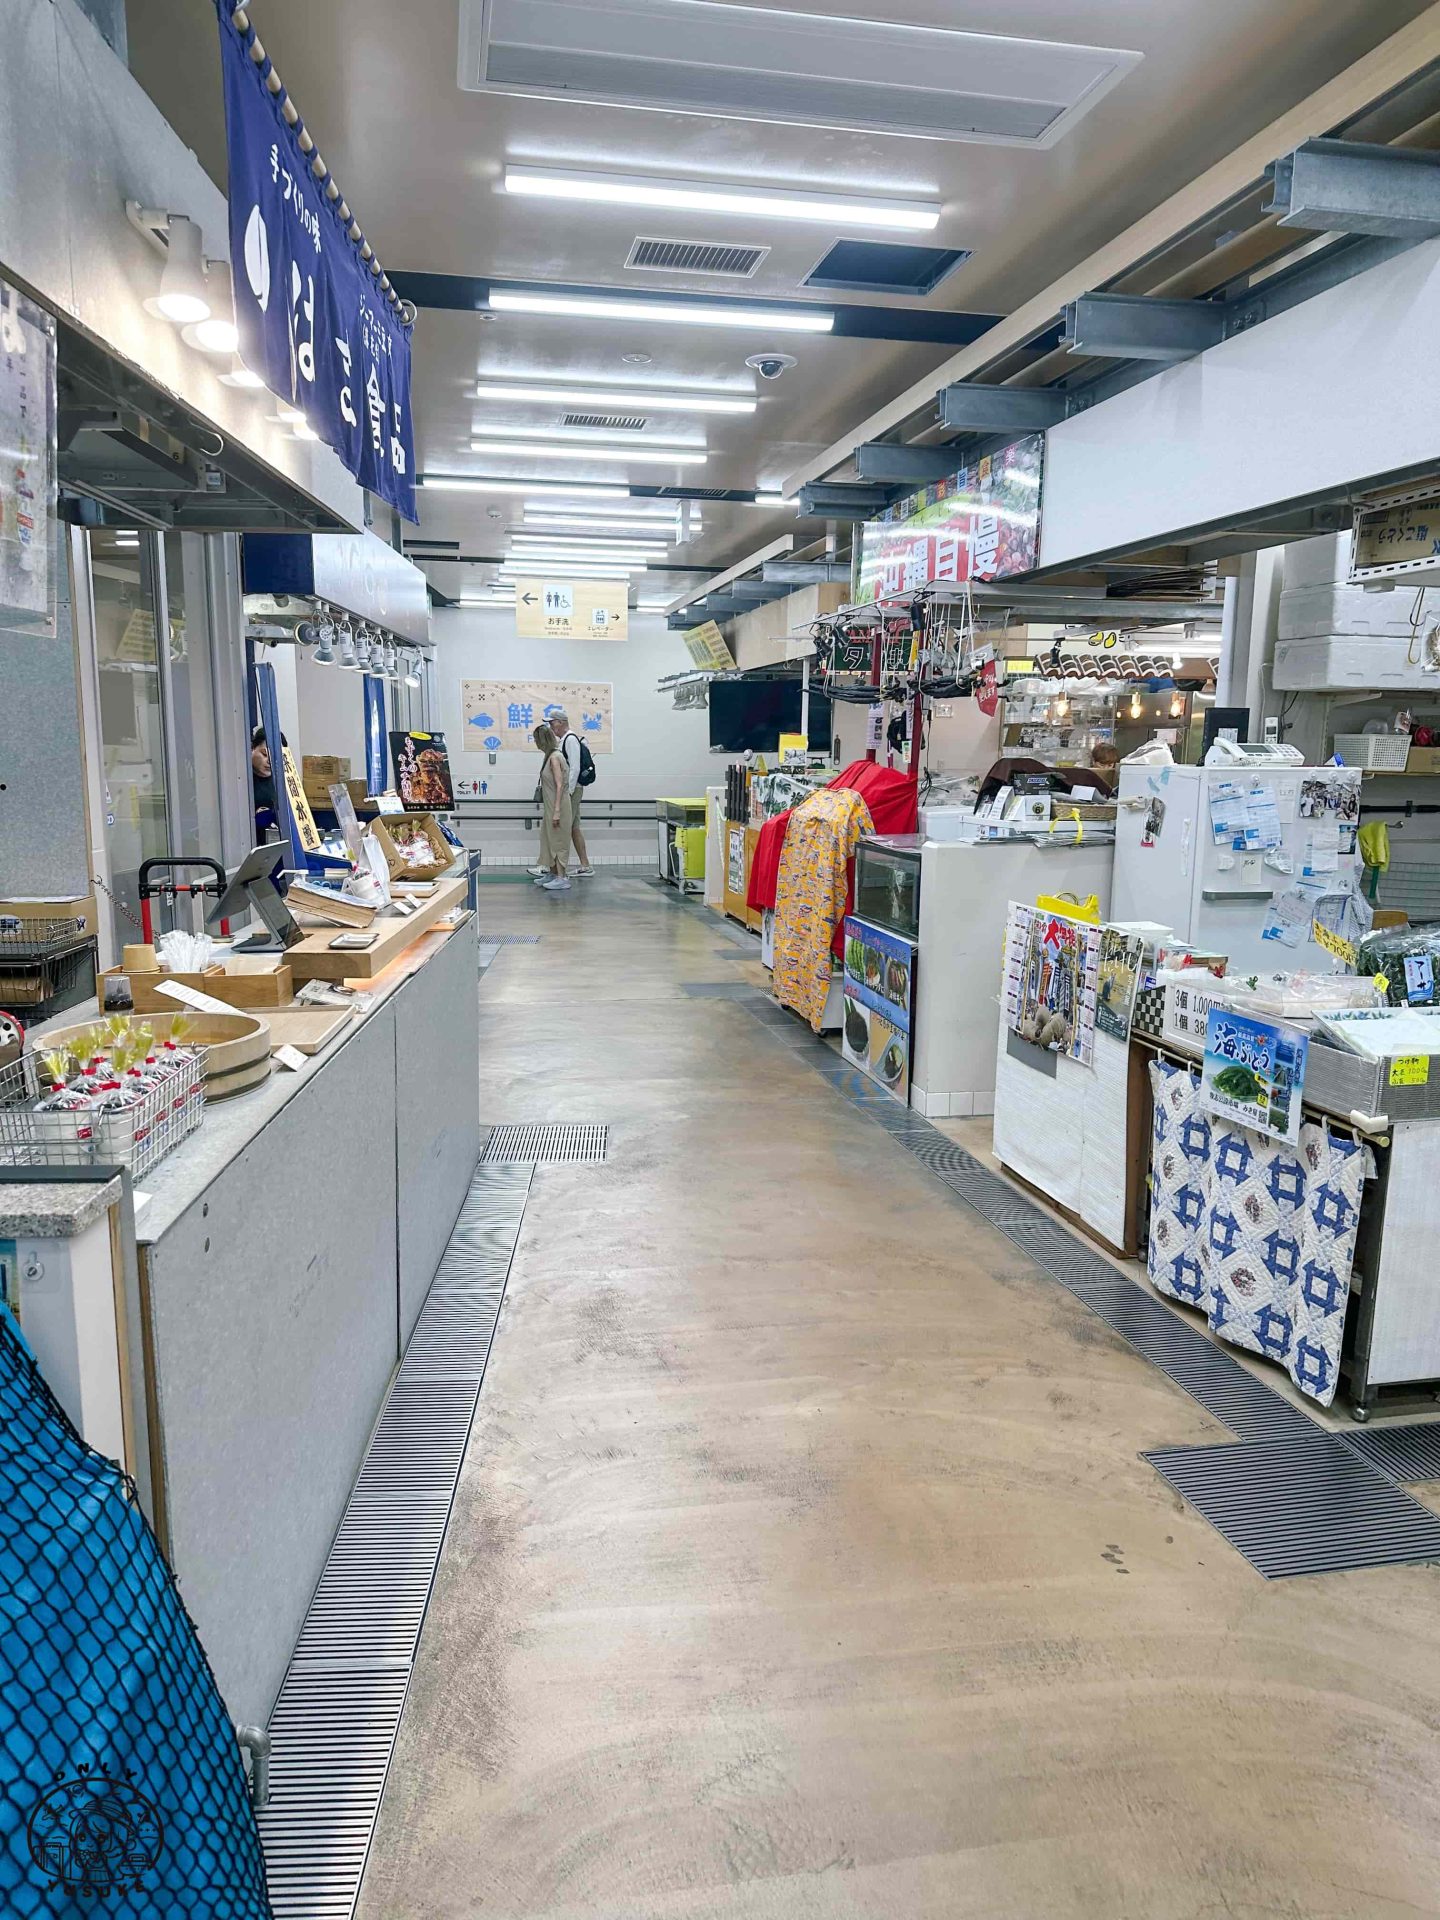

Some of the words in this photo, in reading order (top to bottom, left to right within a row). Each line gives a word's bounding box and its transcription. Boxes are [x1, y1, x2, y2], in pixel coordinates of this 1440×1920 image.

[548, 617, 569, 626] お手洗
[1175, 990, 1188, 1011] 3個
[1174, 1013, 1188, 1030] 1個
[1213, 1022, 1270, 1072] 海ぶどう
